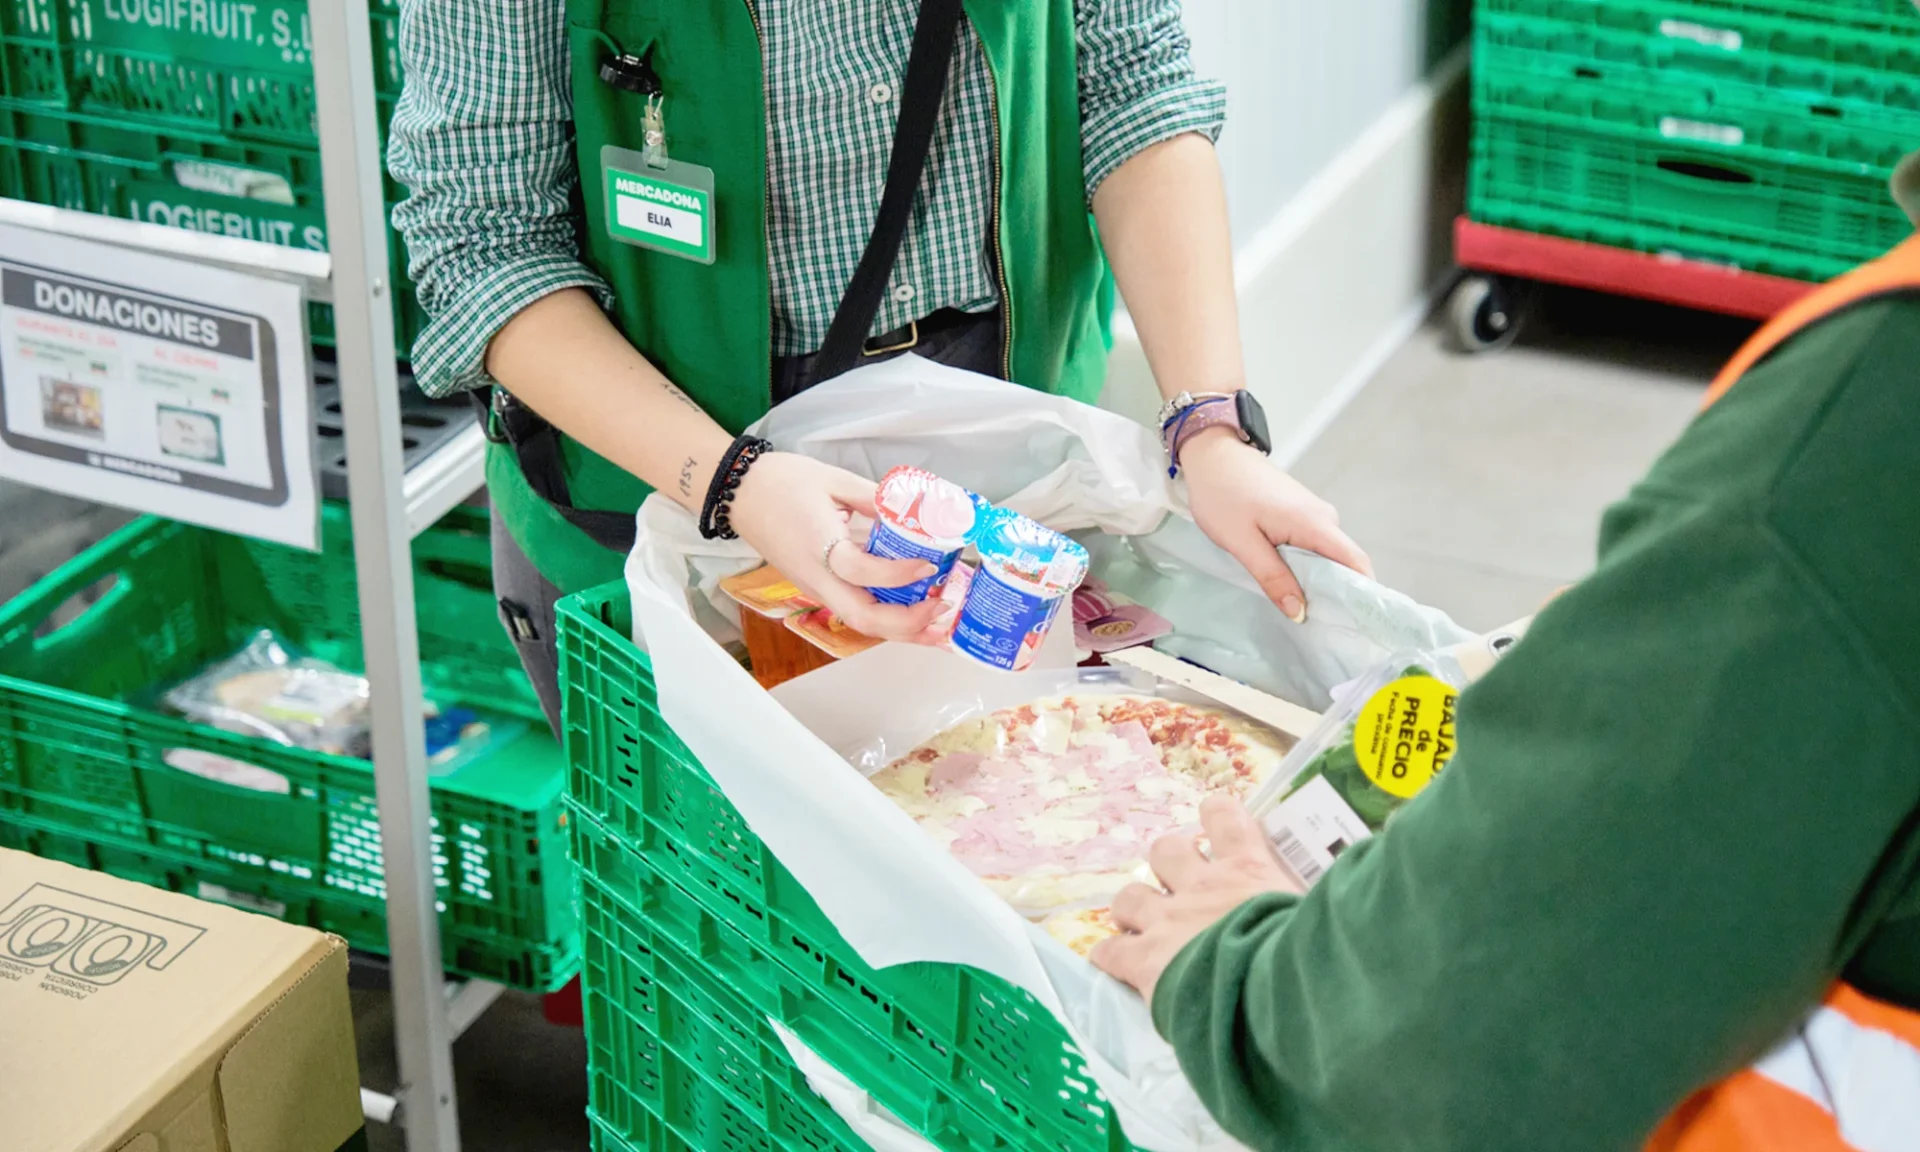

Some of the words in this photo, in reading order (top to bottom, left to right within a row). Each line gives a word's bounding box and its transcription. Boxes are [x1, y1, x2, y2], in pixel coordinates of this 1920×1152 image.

[615, 178, 702, 211] MERCADONA
[646, 212, 672, 228] ELIA
[34, 279, 220, 348] DONACIONES
[679, 456, 698, 497] 1954
[995, 655, 1007, 665] 125
[1387, 691, 1400, 720] Fecha
[1392, 696, 1421, 779] PRECIO
[1416, 730, 1432, 752] de
[1431, 694, 1457, 777] BAJAD
